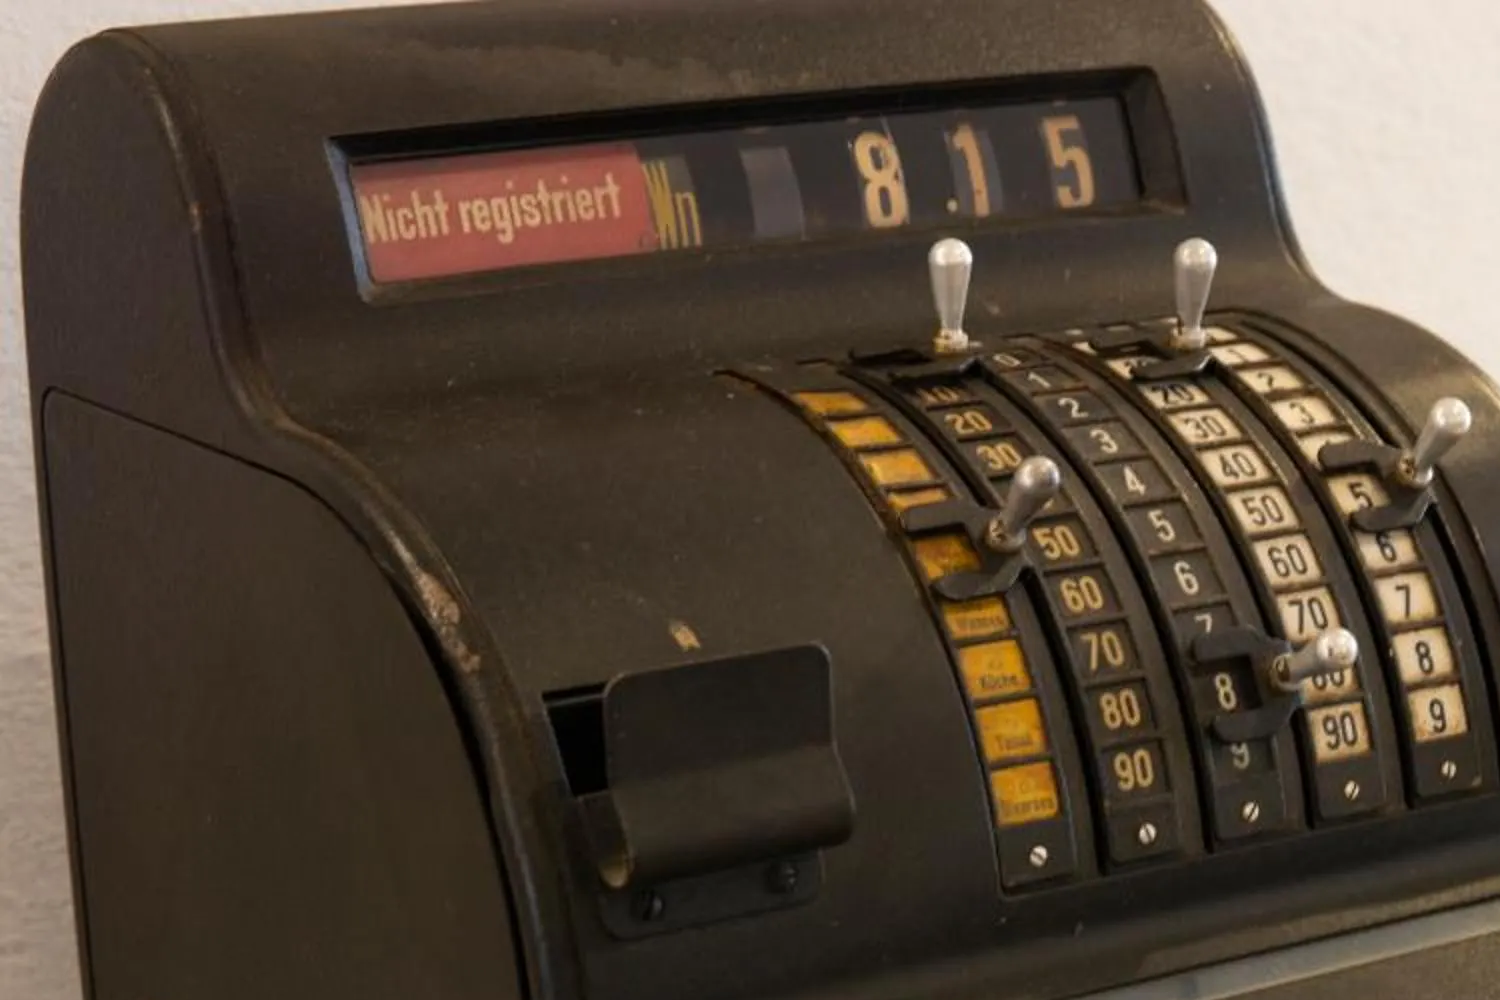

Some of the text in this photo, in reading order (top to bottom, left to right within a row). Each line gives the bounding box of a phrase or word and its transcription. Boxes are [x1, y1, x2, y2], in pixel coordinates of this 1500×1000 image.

[854, 131, 909, 228] 8
[1041, 114, 1095, 209] 5
[359, 171, 622, 245] Nicht registriert
[1026, 372, 1052, 389] 1
[944, 410, 993, 435] 20
[1057, 396, 1089, 419] 2
[1288, 402, 1315, 425] 3
[1089, 428, 1119, 454] 3
[1183, 415, 1227, 439] 30
[975, 441, 1023, 471] 30
[1219, 452, 1257, 480] 40
[1123, 464, 1147, 496] 4
[1347, 482, 1374, 510] 5
[1147, 509, 1176, 543] 5
[1241, 495, 1284, 527] 50
[1032, 524, 1081, 560] 50
[1375, 531, 1398, 563] 6
[1173, 560, 1199, 596] 6
[1266, 543, 1309, 578] 60
[1059, 575, 1104, 614] 60
[1394, 584, 1411, 620] 7
[1287, 596, 1329, 637] 70
[1079, 630, 1126, 672] 70
[1414, 640, 1434, 675] 8
[1100, 687, 1142, 730] 80
[1214, 672, 1238, 711] 8
[1322, 711, 1358, 749] 90
[1428, 698, 1447, 733] 9
[1113, 748, 1155, 792] 90
